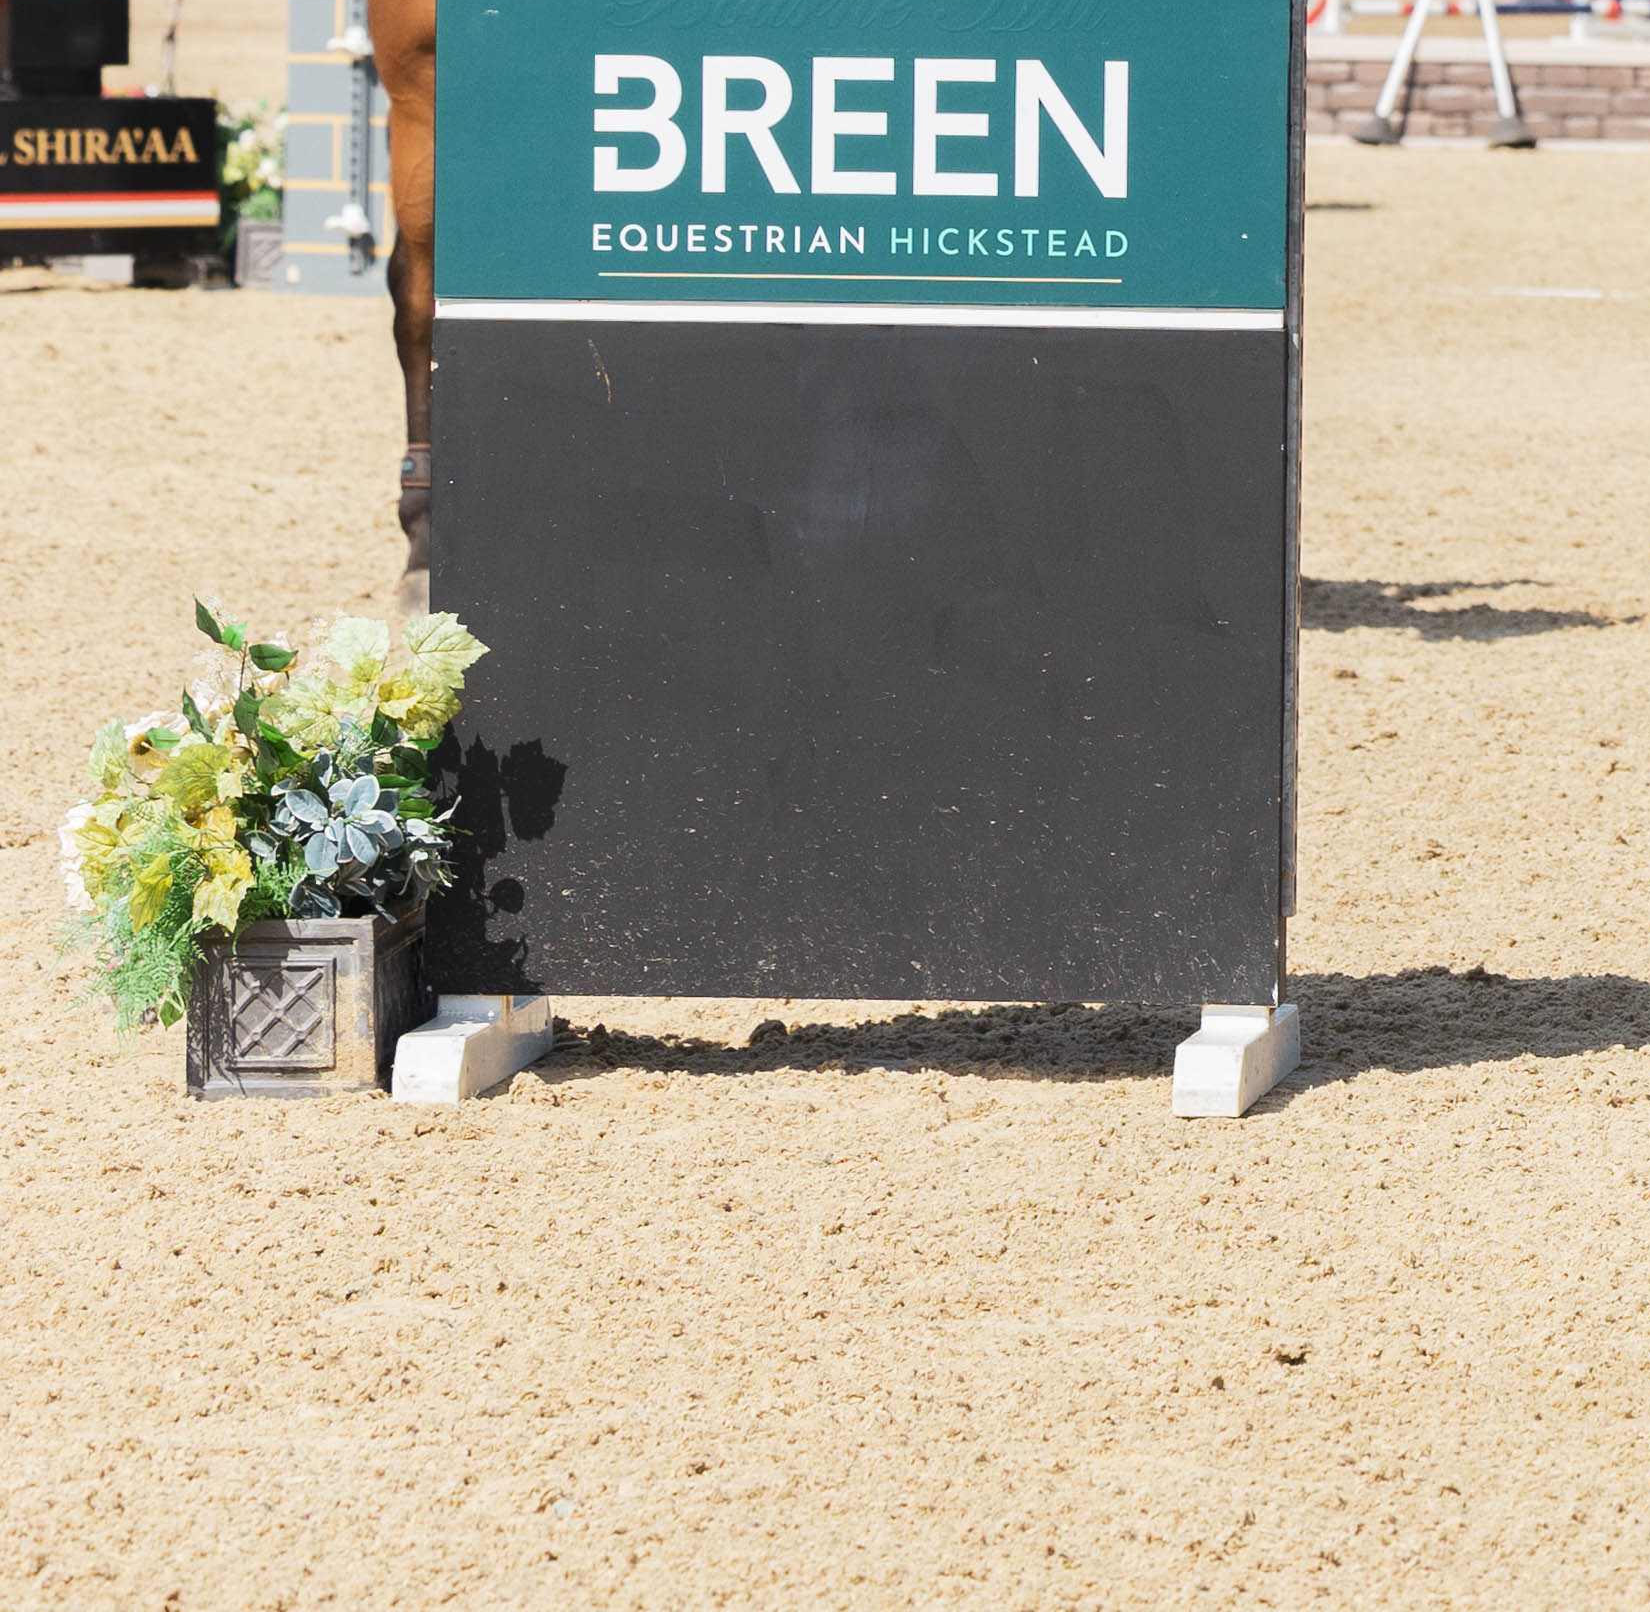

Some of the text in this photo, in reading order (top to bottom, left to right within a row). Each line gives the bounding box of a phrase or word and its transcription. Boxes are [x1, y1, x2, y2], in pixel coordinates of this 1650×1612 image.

[593, 54, 1129, 199] BREEN
[592, 223, 1128, 258] EQUESTRIAN HICKSTEAD
